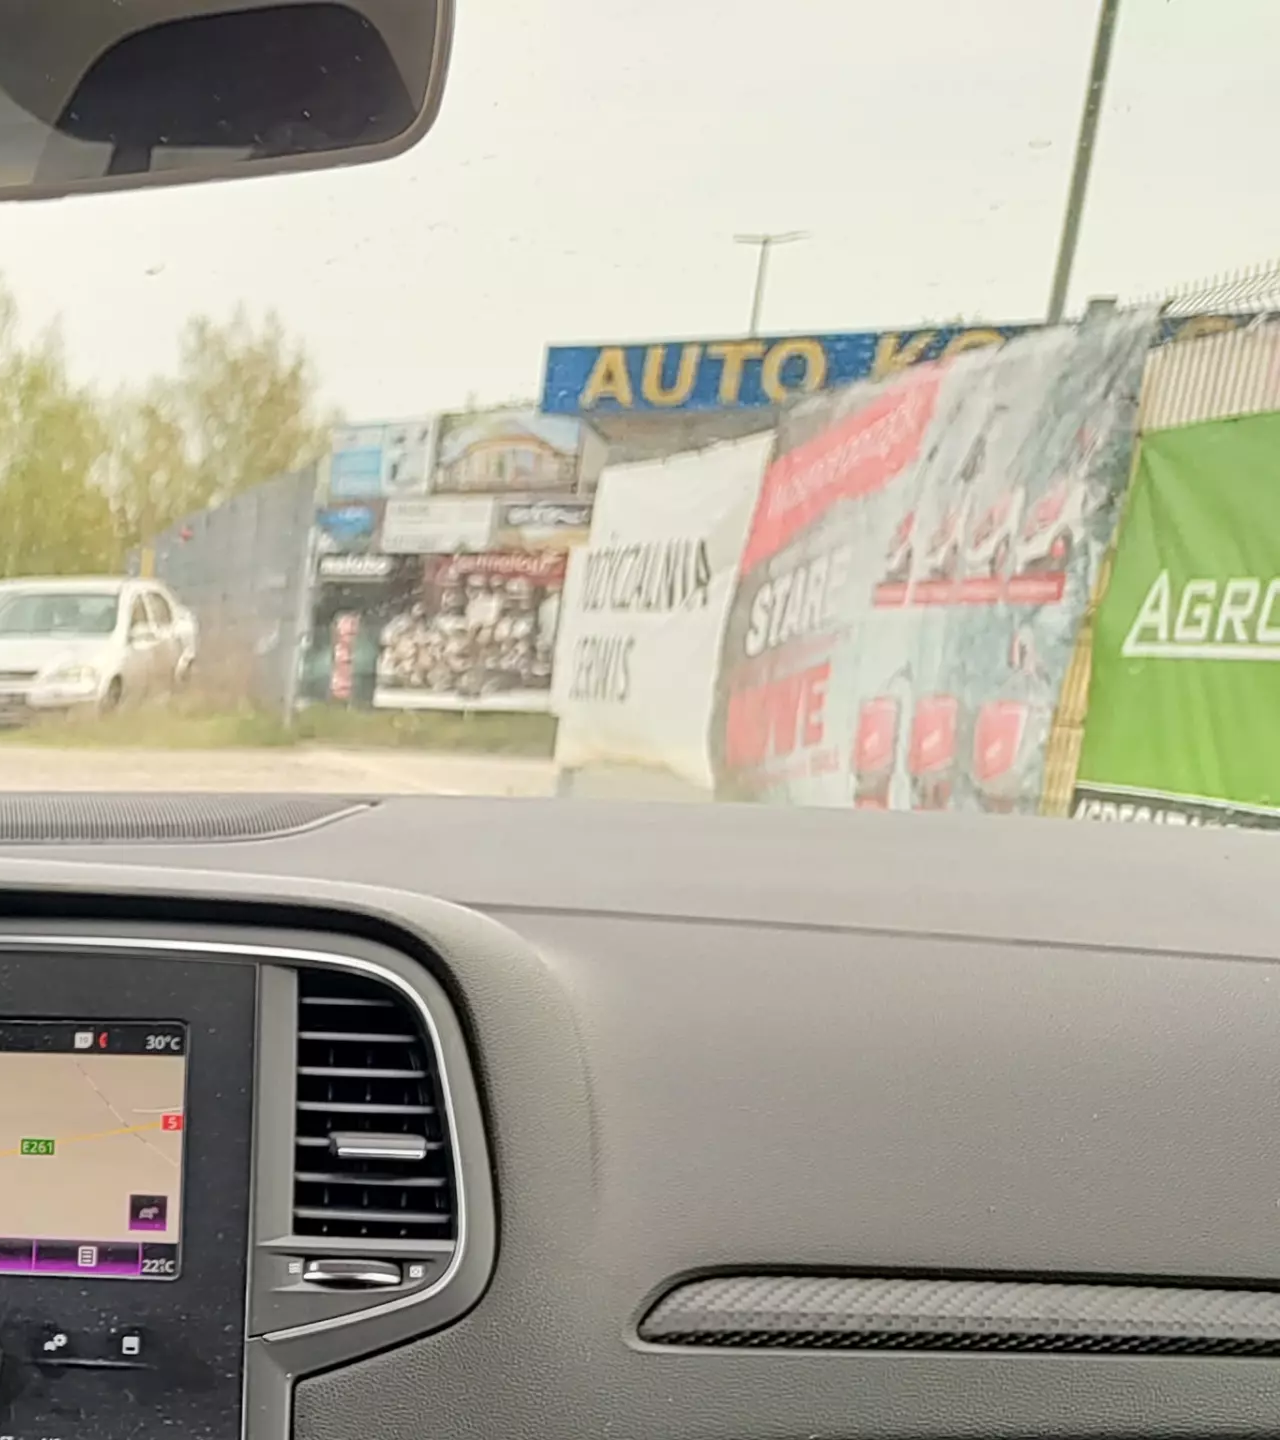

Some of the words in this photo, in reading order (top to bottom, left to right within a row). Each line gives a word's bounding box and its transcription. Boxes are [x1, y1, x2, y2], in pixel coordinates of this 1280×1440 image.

[578, 336, 828, 412] AUTO
[145, 1034, 181, 1051] 30°C
[22, 1140, 54, 1154] E261
